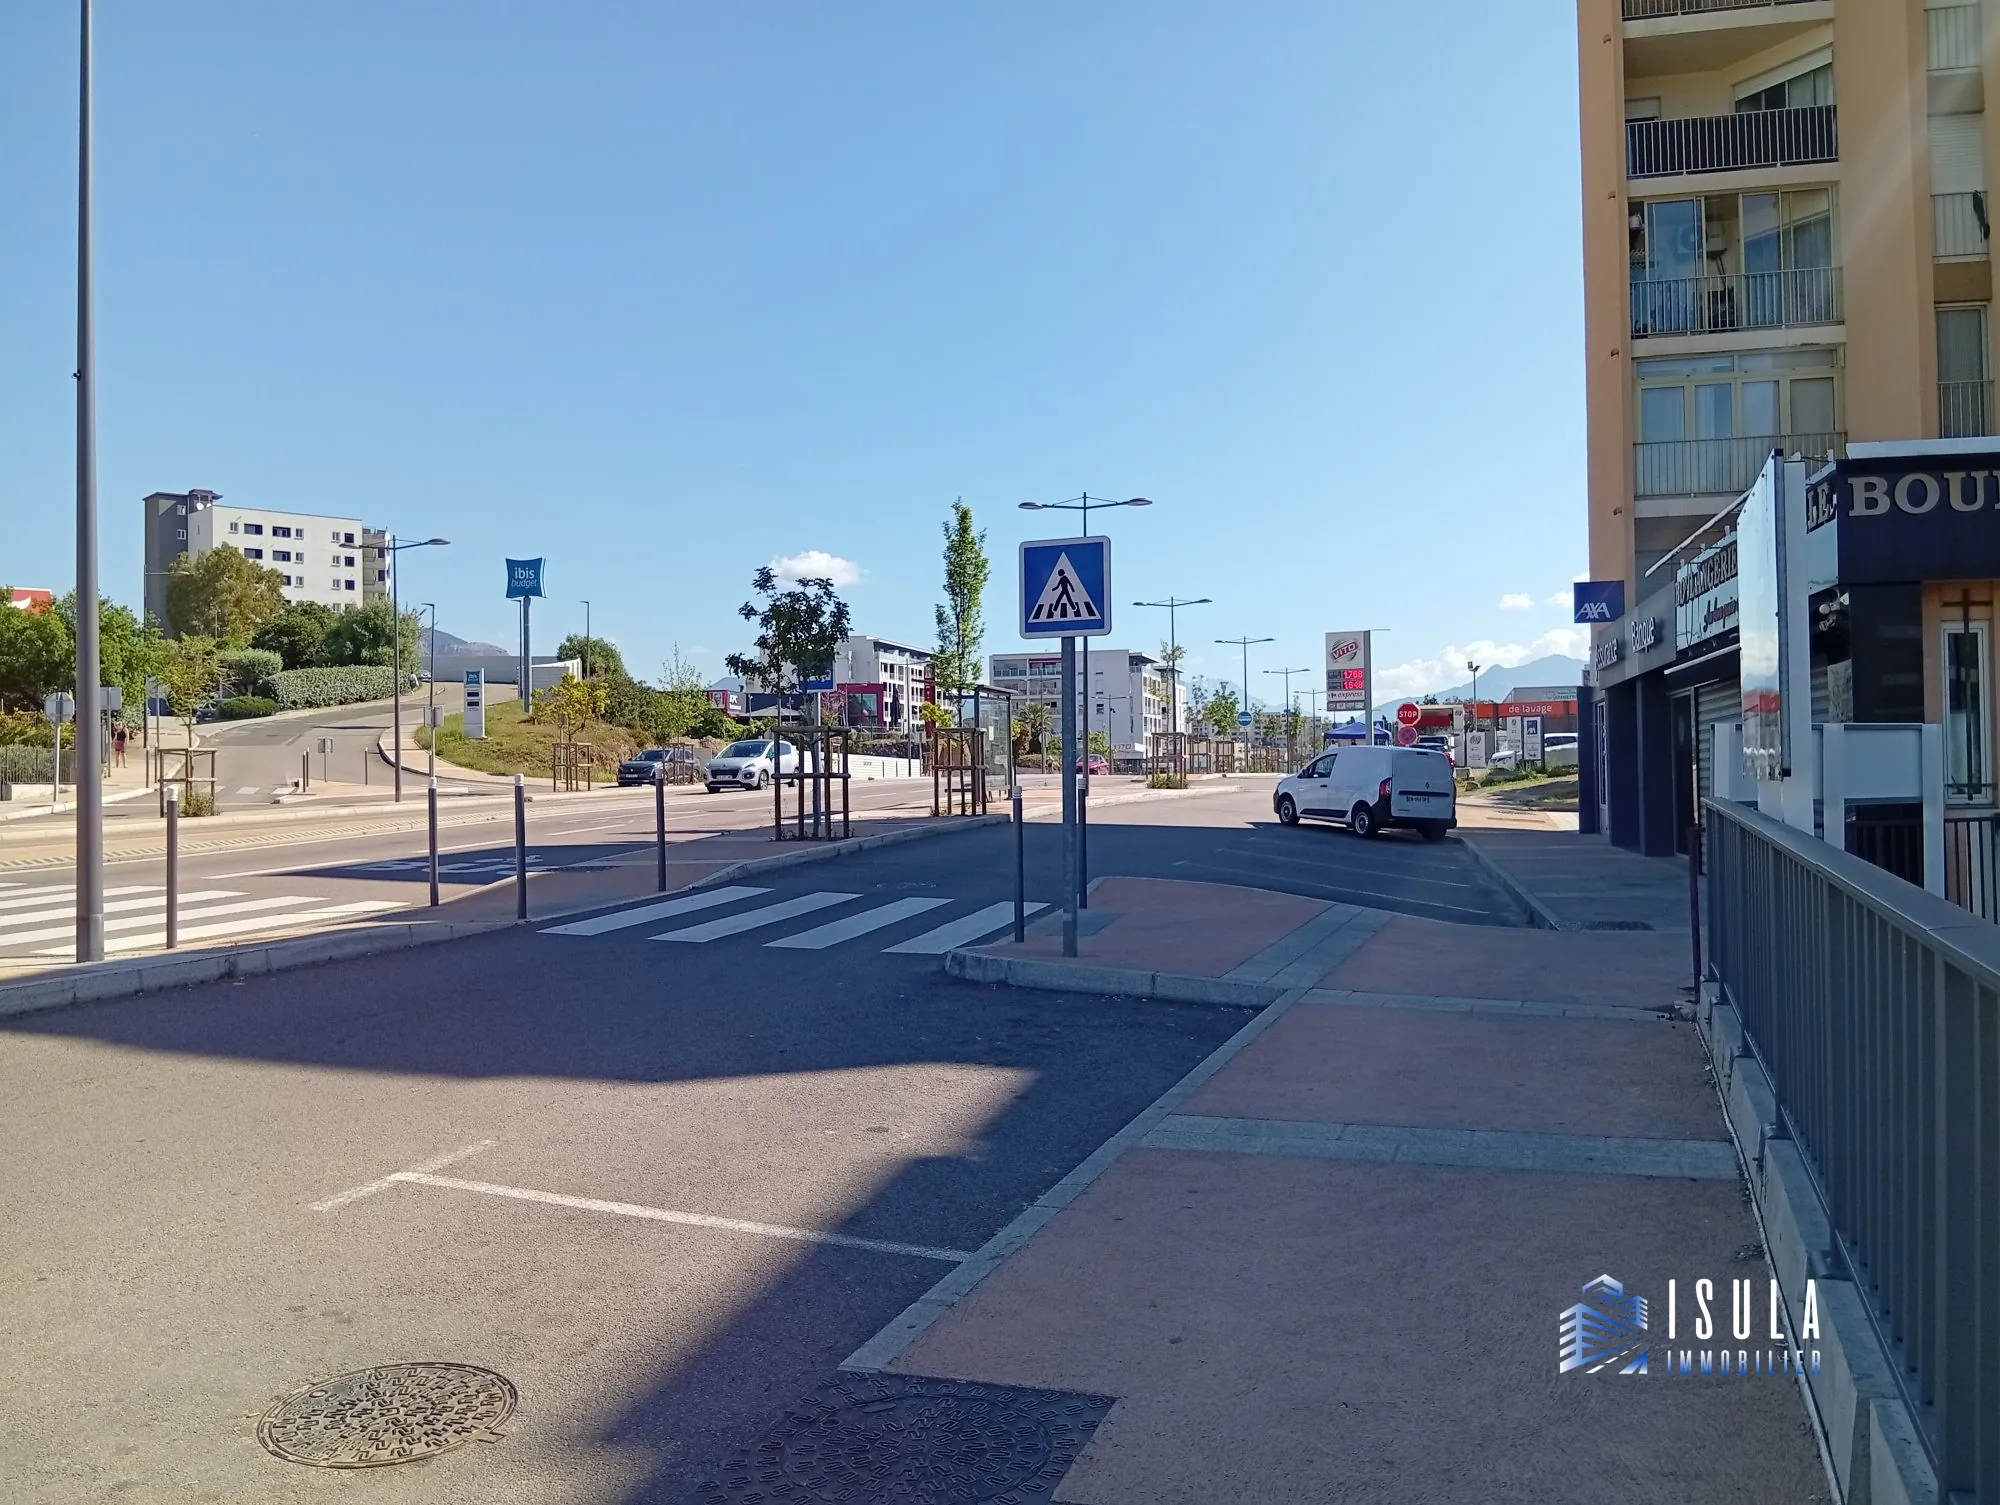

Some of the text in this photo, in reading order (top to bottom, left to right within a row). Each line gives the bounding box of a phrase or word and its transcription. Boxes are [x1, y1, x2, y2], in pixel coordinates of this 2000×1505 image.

[1848, 470, 2000, 516] BOU
[514, 568, 535, 579] ibis
[511, 579, 537, 588] budget
[1574, 602, 1611, 619] AXA
[1631, 616, 1655, 654] Banque
[1332, 642, 1357, 659] VITO
[1595, 638, 1618, 672] Assurance
[1398, 710, 1418, 718] STOP
[1508, 704, 1553, 714] de lavage
